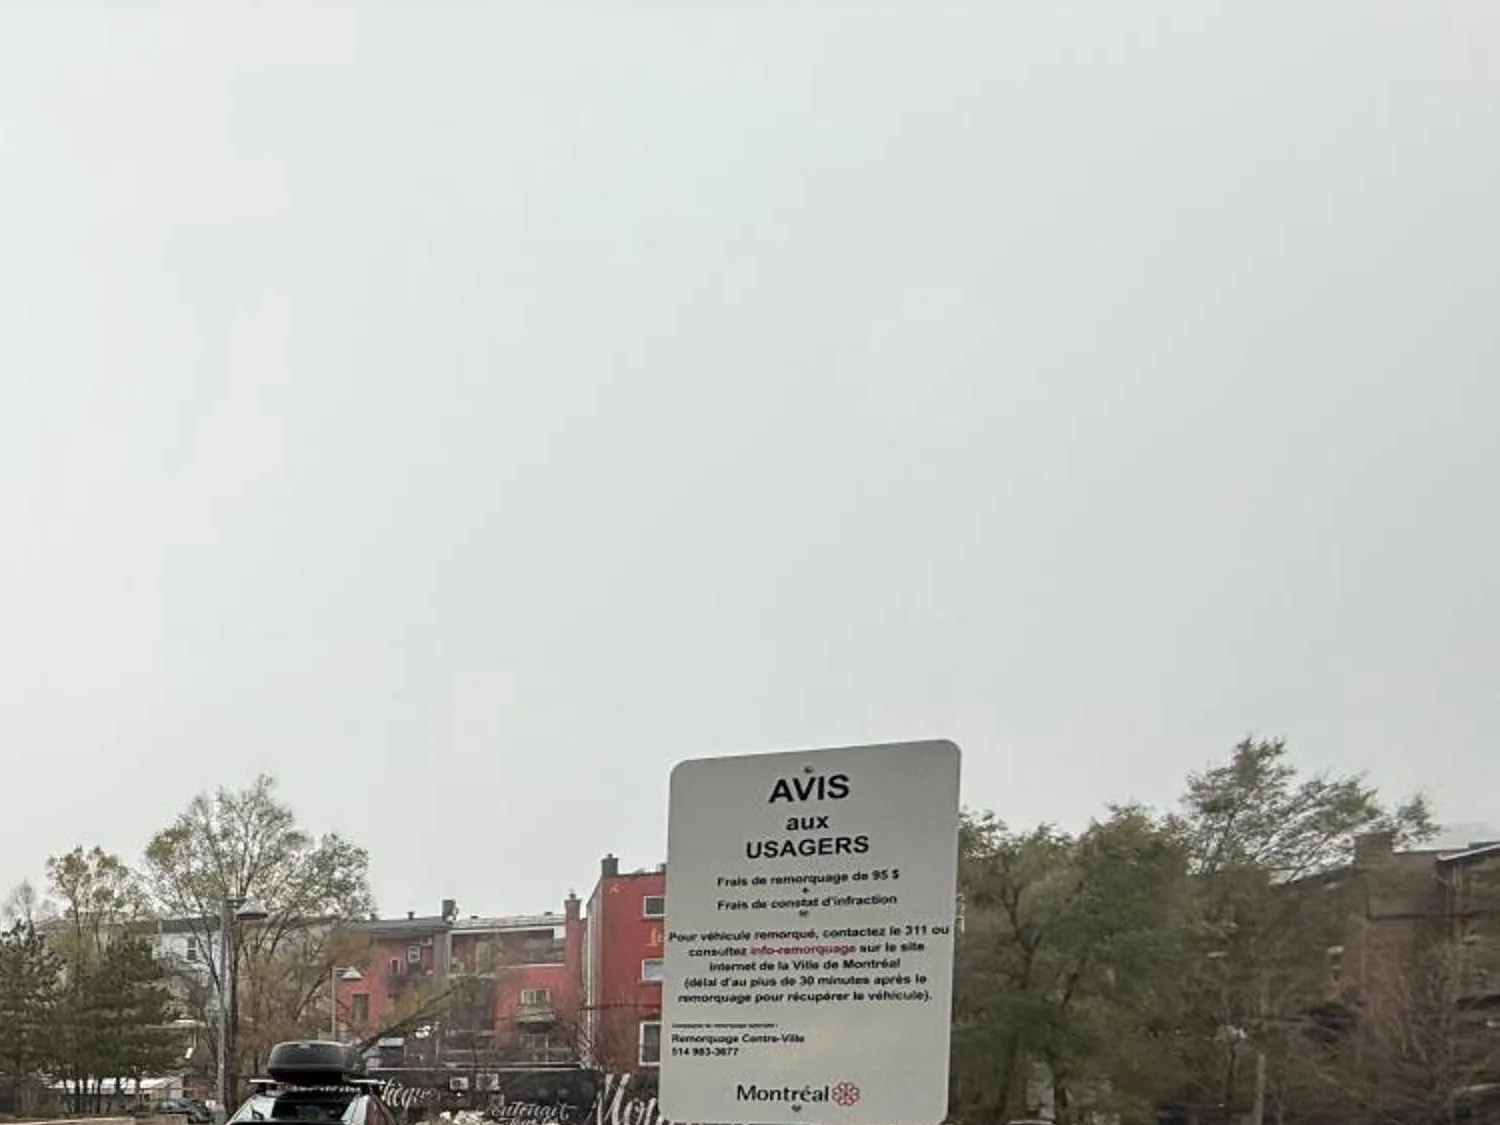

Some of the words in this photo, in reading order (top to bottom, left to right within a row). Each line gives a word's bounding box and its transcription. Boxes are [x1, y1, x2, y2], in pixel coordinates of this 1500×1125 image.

[768, 774, 850, 803] AVIS
[786, 814, 829, 831] aux
[746, 836, 868, 859] USAGERS
[717, 877, 748, 887] Frais
[751, 875, 767, 885] de
[771, 870, 848, 885] remorquage
[852, 870, 868, 882] de
[872, 870, 888, 881] 95
[891, 868, 900, 881] $
[717, 900, 748, 910] Frais
[752, 898, 768, 909] de
[771, 897, 817, 909] constat
[822, 894, 897, 906] d'infraction
[669, 932, 697, 942] Pour
[700, 930, 750, 941] véhicule
[754, 929, 818, 942] remorqué,
[823, 926, 885, 937] contactez
[889, 926, 901, 936] le
[905, 925, 927, 936] 311
[931, 926, 949, 935] ou
[688, 946, 747, 957] consultez
[750, 944, 856, 957] info-remorquage
[859, 944, 880, 953] sur
[885, 942, 897, 953] le
[901, 942, 925, 952] site
[760, 961, 776, 971] de
[779, 961, 788, 971] la
[792, 960, 820, 970] Ville
[824, 959, 839, 970] de
[843, 958, 900, 969] Montréal
[684, 977, 716, 989] (délai
[720, 976, 746, 987] d'au
[750, 976, 776, 988] plus
[780, 976, 796, 986] de
[799, 976, 814, 986] 30
[818, 975, 870, 986] minutes
[874, 974, 910, 986] après
[915, 974, 927, 984] le
[678, 992, 751, 1004] remorquage
[755, 993, 783, 1004] pour
[787, 991, 849, 1003] récupérer
[854, 991, 865, 1001] le
[868, 989, 933, 1002] véhicule).
[671, 1034, 739, 1045] Remorquage
[742, 1033, 805, 1043] Centre-Ville
[671, 1047, 690, 1057] 514
[736, 1084, 829, 1103] Montréal
